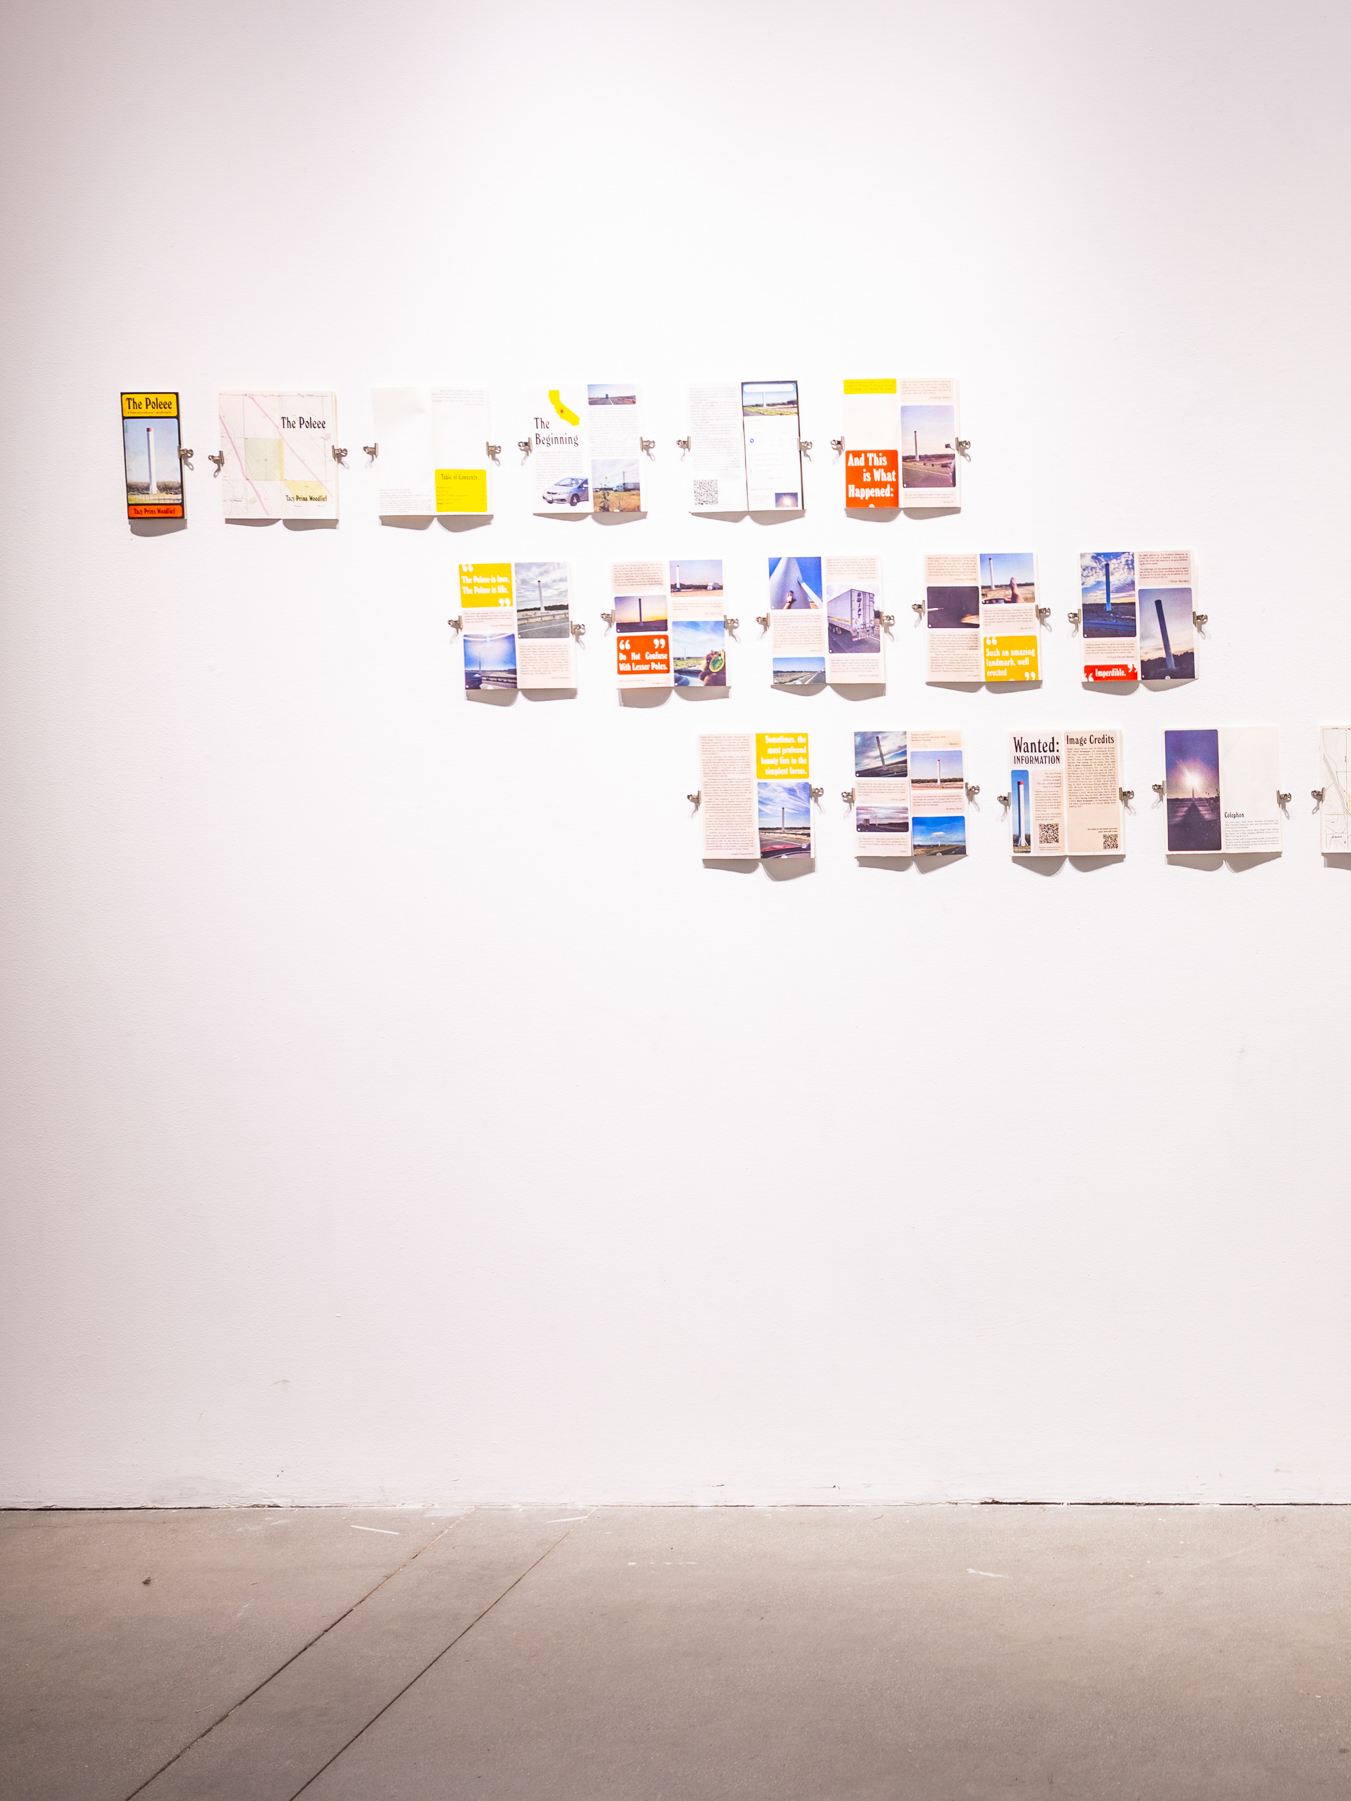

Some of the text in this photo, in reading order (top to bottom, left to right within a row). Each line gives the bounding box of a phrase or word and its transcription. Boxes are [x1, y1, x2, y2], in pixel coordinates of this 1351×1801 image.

[126, 398, 172, 409] The Poleee
[281, 417, 326, 428] The Poleee
[534, 417, 550, 429] The
[535, 433, 579, 448] Beginning
[848, 453, 887, 466] And This
[863, 468, 896, 482] is What
[848, 484, 894, 500] Happened:
[498, 585, 509, 593] life.
[631, 652, 641, 660] Not
[645, 651, 668, 660] Confuse
[986, 648, 1000, 656] Such
[1011, 648, 1035, 657] amazing
[619, 662, 668, 671] With Lesser Poles.
[1017, 657, 1029, 666] well
[1096, 669, 1126, 678] Imperdible.
[798, 735, 806, 743] the
[1066, 734, 1114, 746] Image Credits
[1013, 737, 1060, 753] Wanted:
[782, 745, 807, 756] profound
[761, 756, 807, 766] beauty lies in the
[1014, 755, 1060, 764] INFORMATION
[765, 766, 807, 776] simplest forms.
